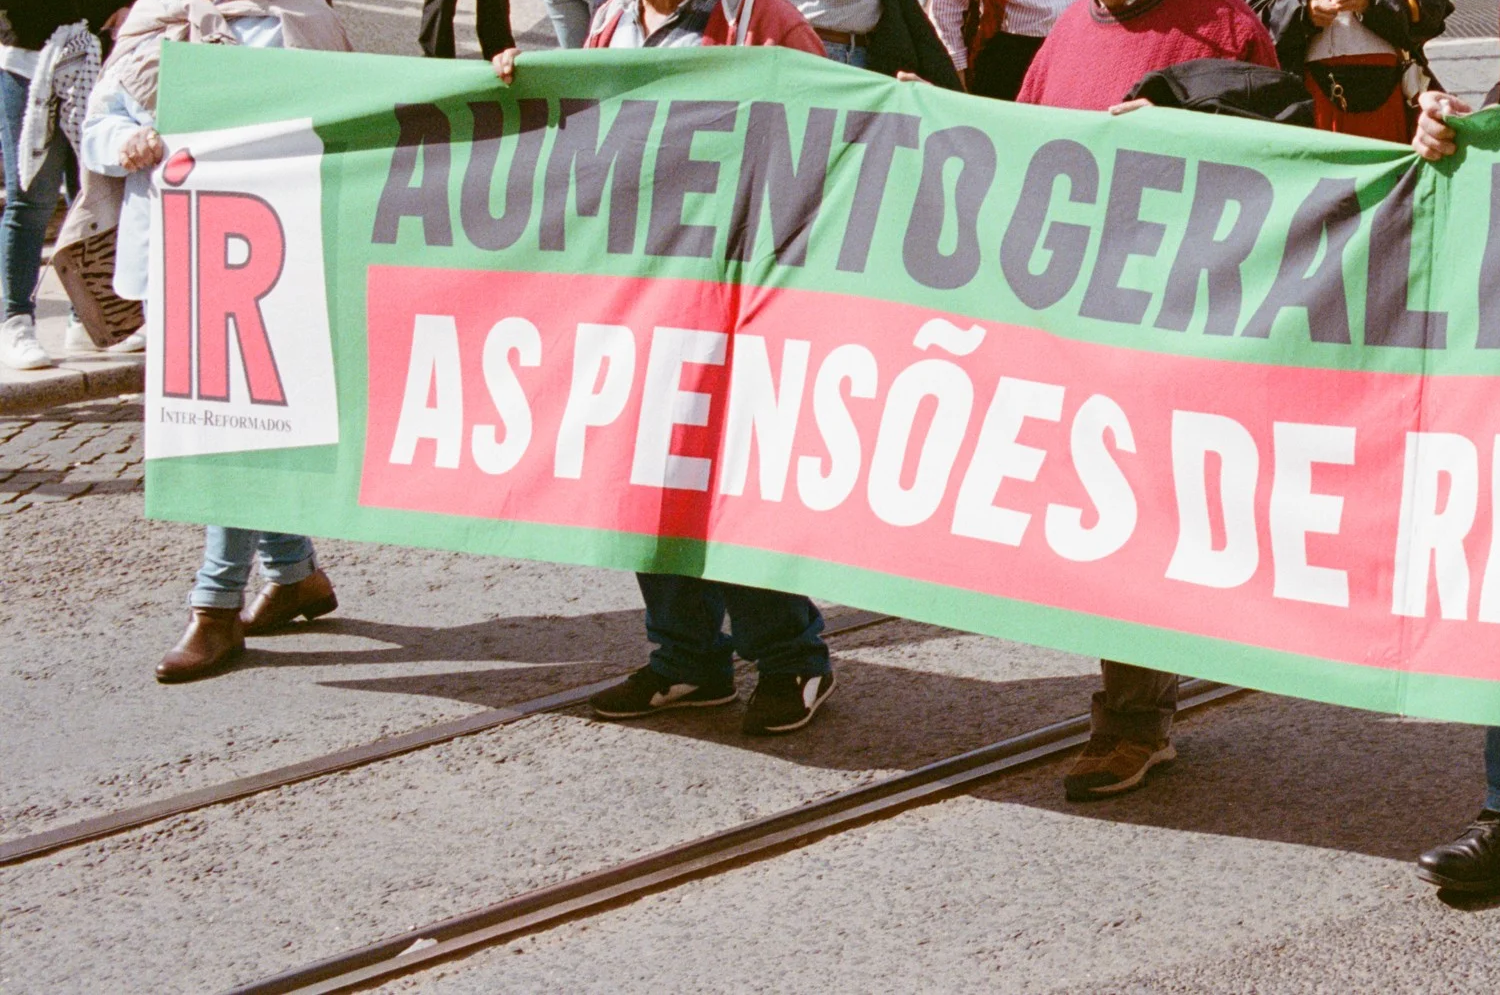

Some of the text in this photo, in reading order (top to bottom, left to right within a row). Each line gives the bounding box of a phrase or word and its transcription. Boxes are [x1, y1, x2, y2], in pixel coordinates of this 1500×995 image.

[371, 98, 997, 290] AUMENTO
[1000, 138, 1448, 350] GERAL
[389, 314, 542, 475] AS
[554, 317, 1138, 563] PENSÕES
[1164, 409, 1357, 609] DE
